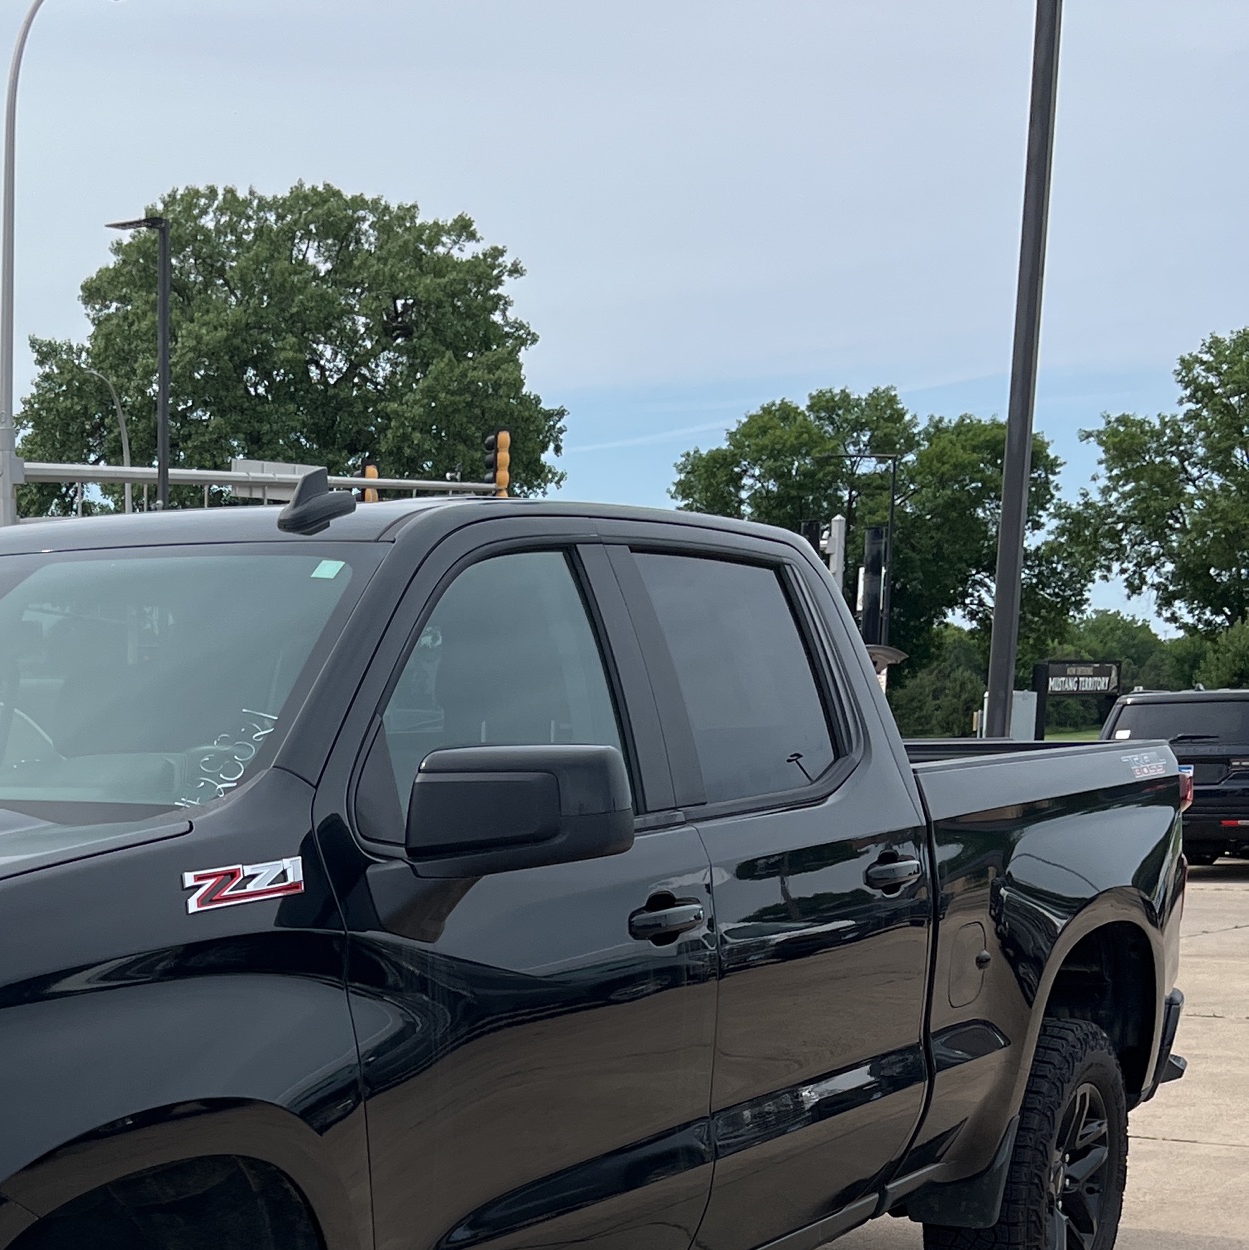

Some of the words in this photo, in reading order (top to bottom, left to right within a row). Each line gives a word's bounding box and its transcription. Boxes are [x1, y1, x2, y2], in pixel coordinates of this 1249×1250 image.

[1048, 676, 1078, 692] MUSTANG
[1078, 676, 1110, 691] TERRITORY
[1134, 763, 1166, 779] BOSS
[181, 855, 305, 914] Z71
